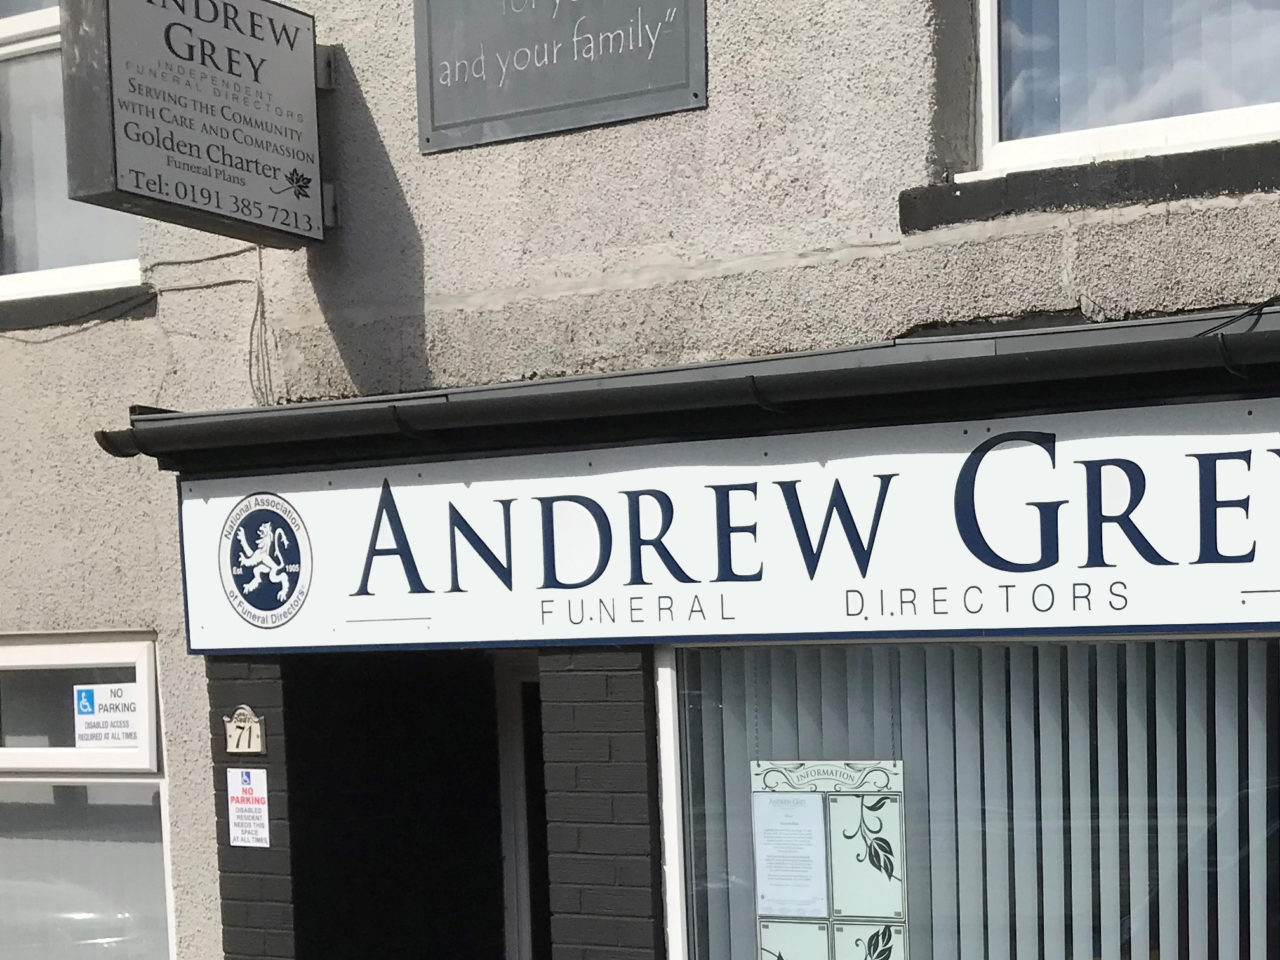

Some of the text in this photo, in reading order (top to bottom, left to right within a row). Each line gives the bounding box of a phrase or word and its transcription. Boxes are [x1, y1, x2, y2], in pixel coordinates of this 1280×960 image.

[146, 0, 300, 51] NDREW
[164, 22, 267, 84] GREY
[438, 42, 486, 87] and
[496, 40, 562, 87] your
[125, 60, 305, 123] FUNERAL DIRECTORS
[157, 60, 273, 102] INDEPENDENT
[118, 98, 315, 164] WITH CARE AND COMPASSION
[128, 78, 303, 142] SERVING THE COMMUNITY
[124, 121, 281, 181] Golden Charter
[166, 155, 246, 187] Funeral Plans
[129, 168, 313, 232] Tel: 0191 385 7213
[223, 497, 301, 541] National Association
[348, 473, 900, 597] ANDREW
[228, 589, 305, 625] of Funeral Directors
[540, 581, 1130, 625] FUNERAL DIRECTORS
[98, 702, 137, 713] PARKING
[110, 688, 124, 698] NO
[110, 720, 130, 728] ACCESS
[122, 731, 138, 740] TIMES
[235, 725, 252, 749] 71
[241, 787, 254, 796] NO
[796, 768, 856, 782] INFORMATION
[230, 796, 266, 805] PARKING
